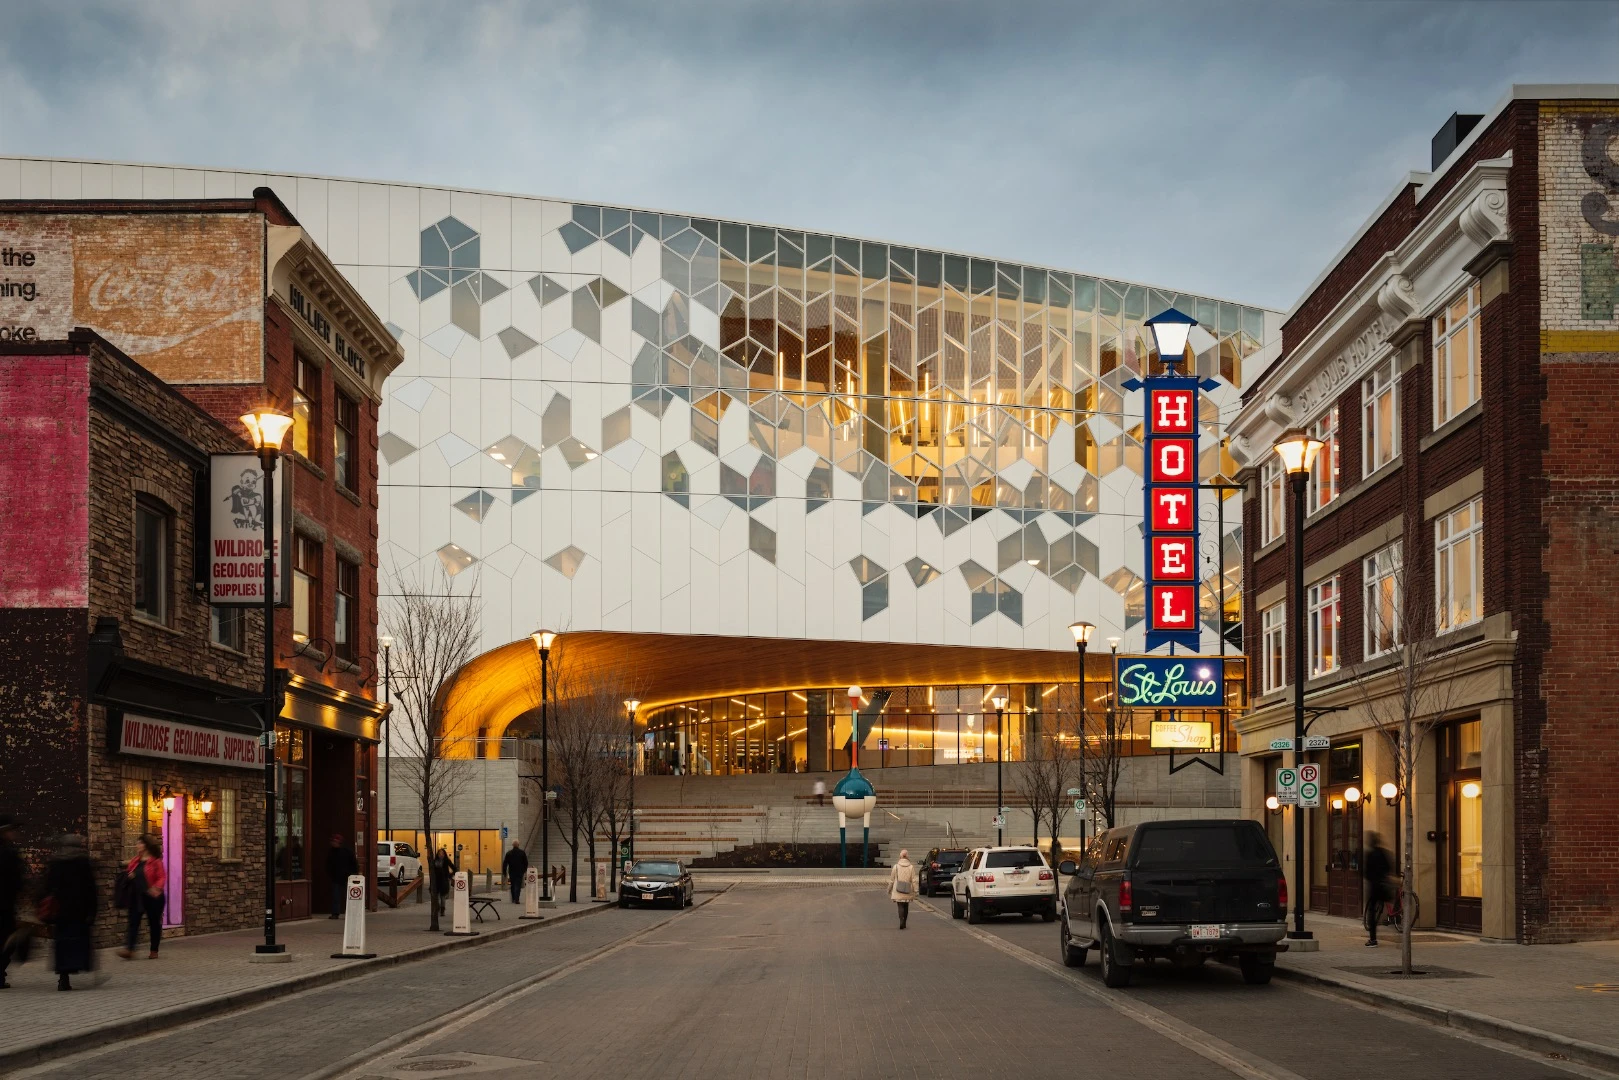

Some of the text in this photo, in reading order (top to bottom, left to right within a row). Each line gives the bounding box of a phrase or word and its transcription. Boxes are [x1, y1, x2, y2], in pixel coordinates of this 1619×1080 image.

[1, 247, 36, 267] the
[290, 284, 365, 380] HILLIER BLOCK
[1315, 354, 1349, 397] LOUIS
[1347, 317, 1394, 368] HOTEL
[1158, 396, 1188, 623] HOTEL
[214, 539, 278, 557] WILDROE
[213, 562, 279, 578] GEOLOGICL
[214, 583, 256, 596] SUPPLIES
[1151, 663, 1217, 704] Louis
[124, 719, 170, 752] WILDROSE
[173, 728, 220, 759] GEOLOGICAL
[223, 735, 256, 764] SUPPLIES
[1155, 724, 1177, 733] COFFEE
[1171, 724, 1207, 746] Shop
[1308, 739, 1325, 747] 2327
